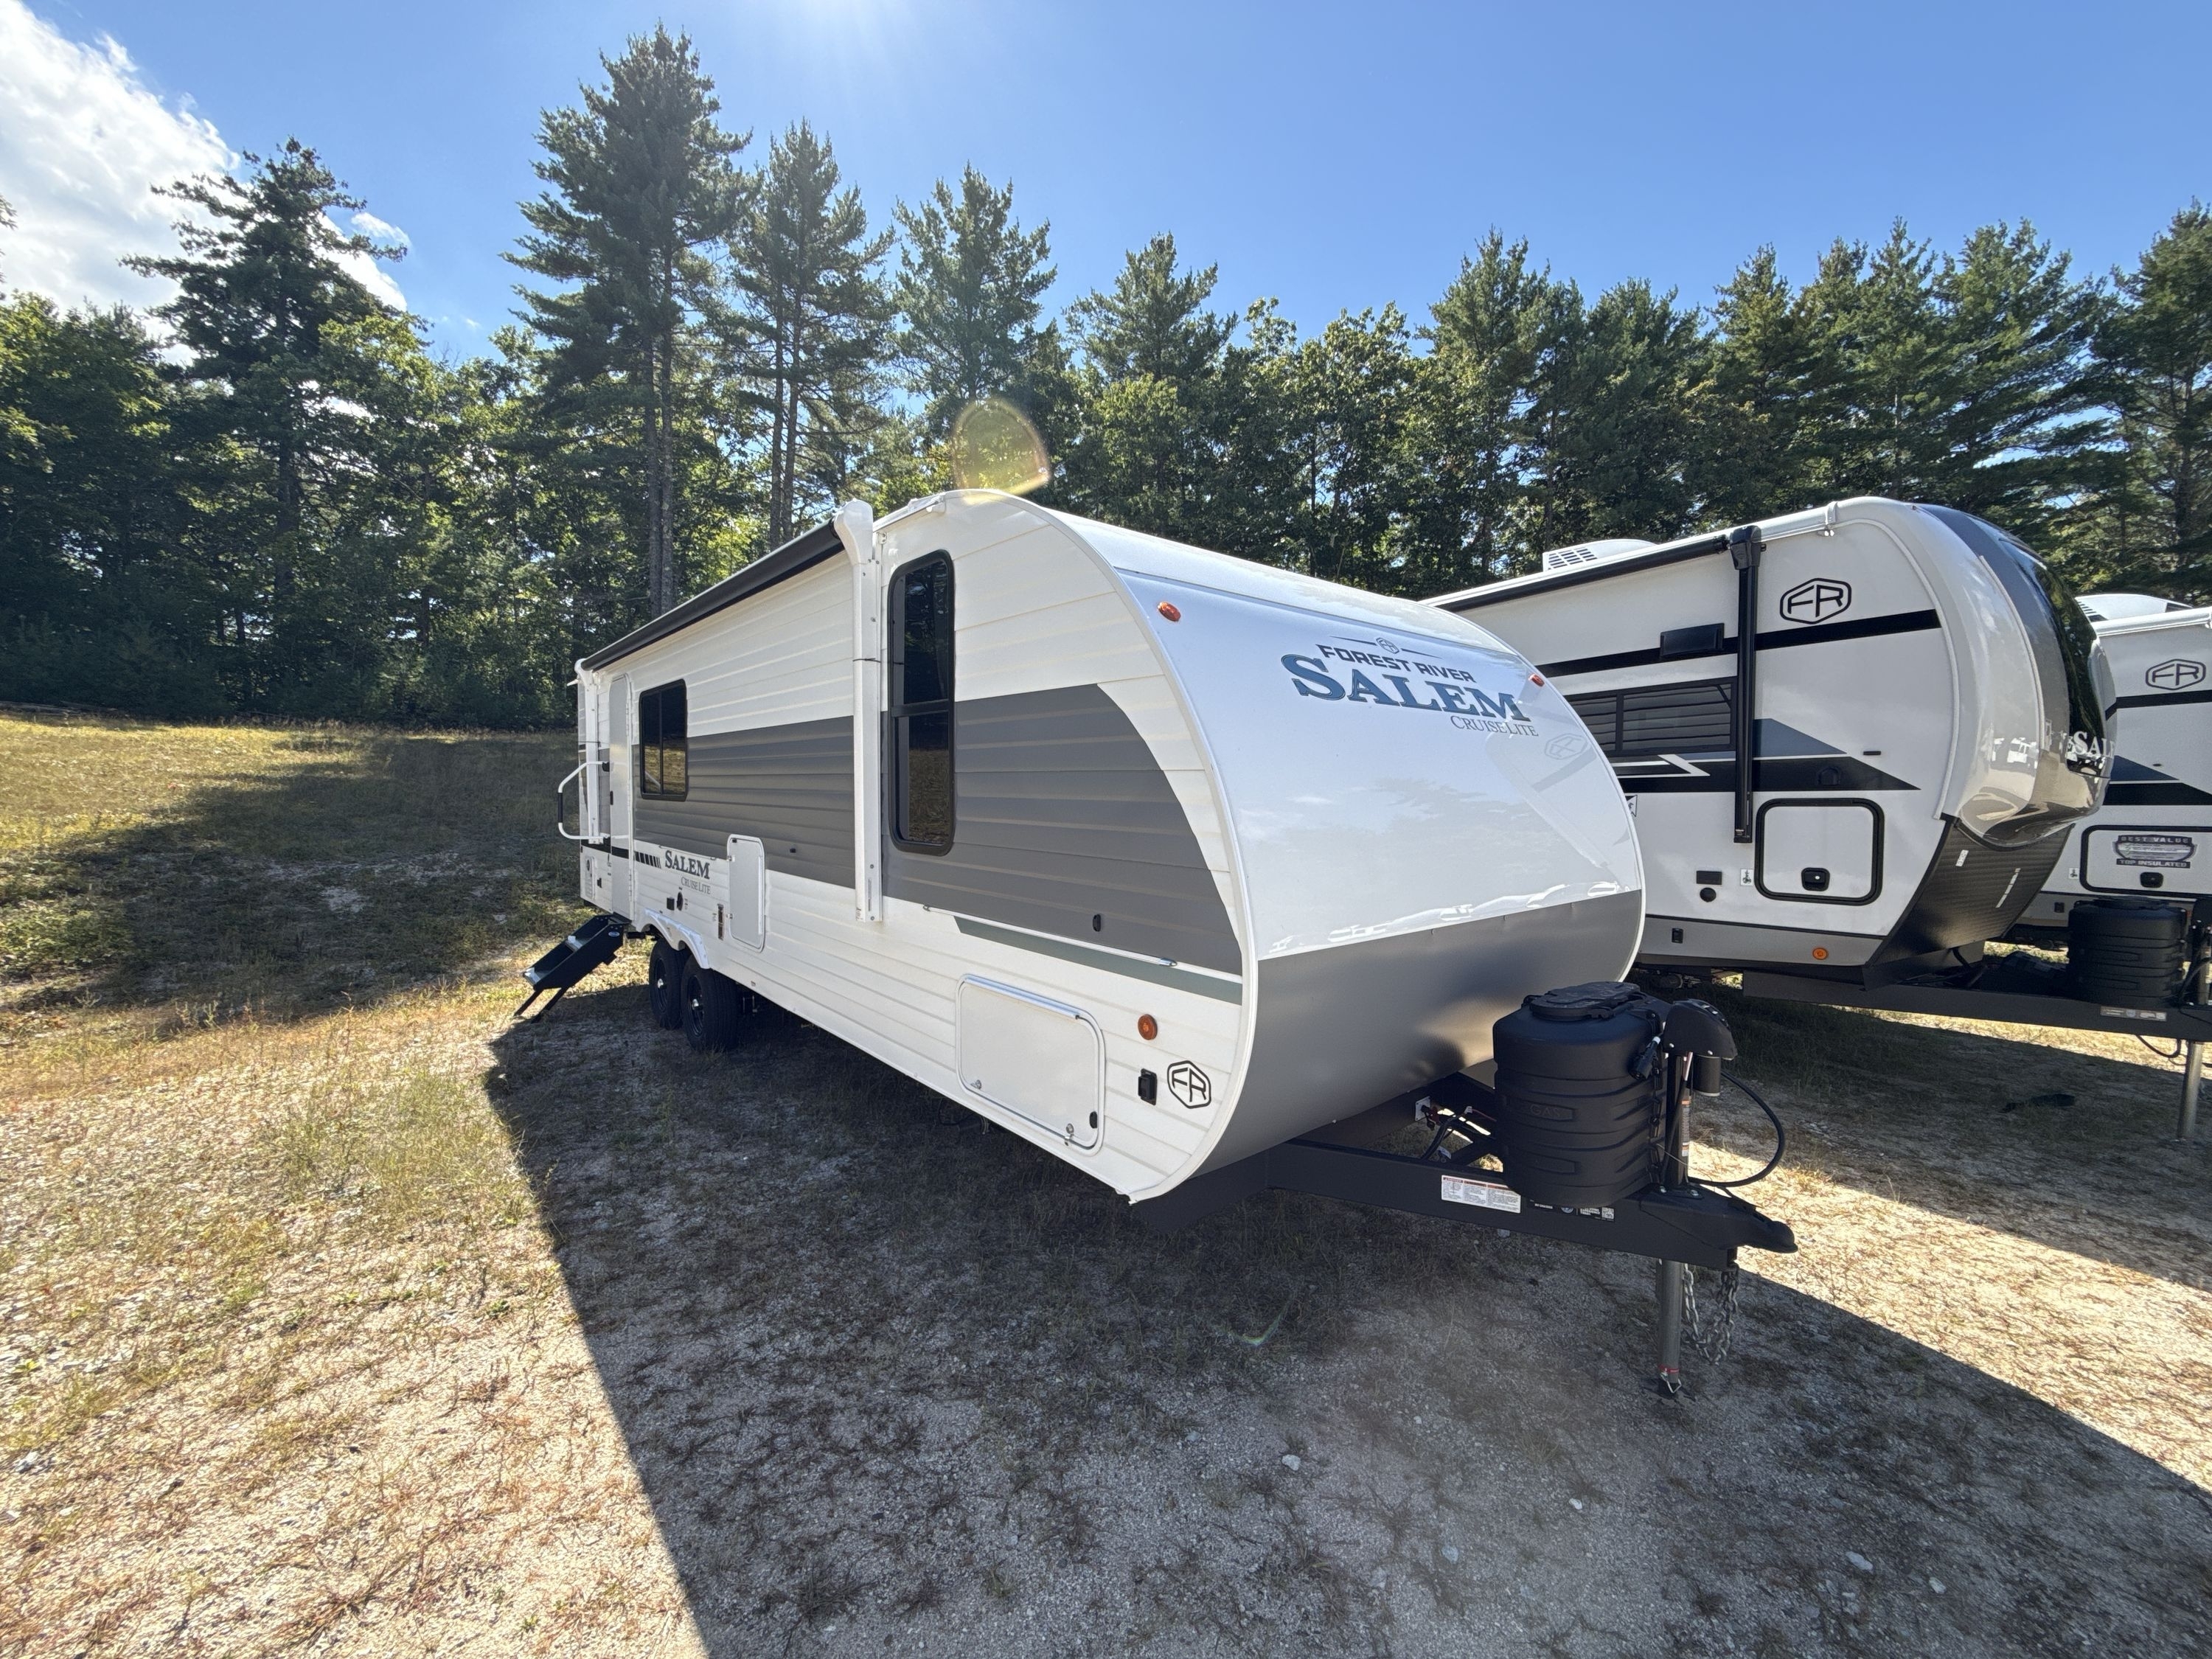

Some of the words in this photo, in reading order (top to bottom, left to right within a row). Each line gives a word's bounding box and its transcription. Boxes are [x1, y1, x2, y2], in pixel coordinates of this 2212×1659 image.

[1788, 585, 1844, 616] FR
[1315, 644, 1413, 672] FOREST
[1415, 662, 1476, 684] RIVER
[2152, 663, 2199, 686] FR
[1281, 653, 1531, 722] SALEM
[665, 850, 710, 880] SALEM
[1172, 1067, 1207, 1103] FR
[1530, 1104, 1561, 1118] GAS
